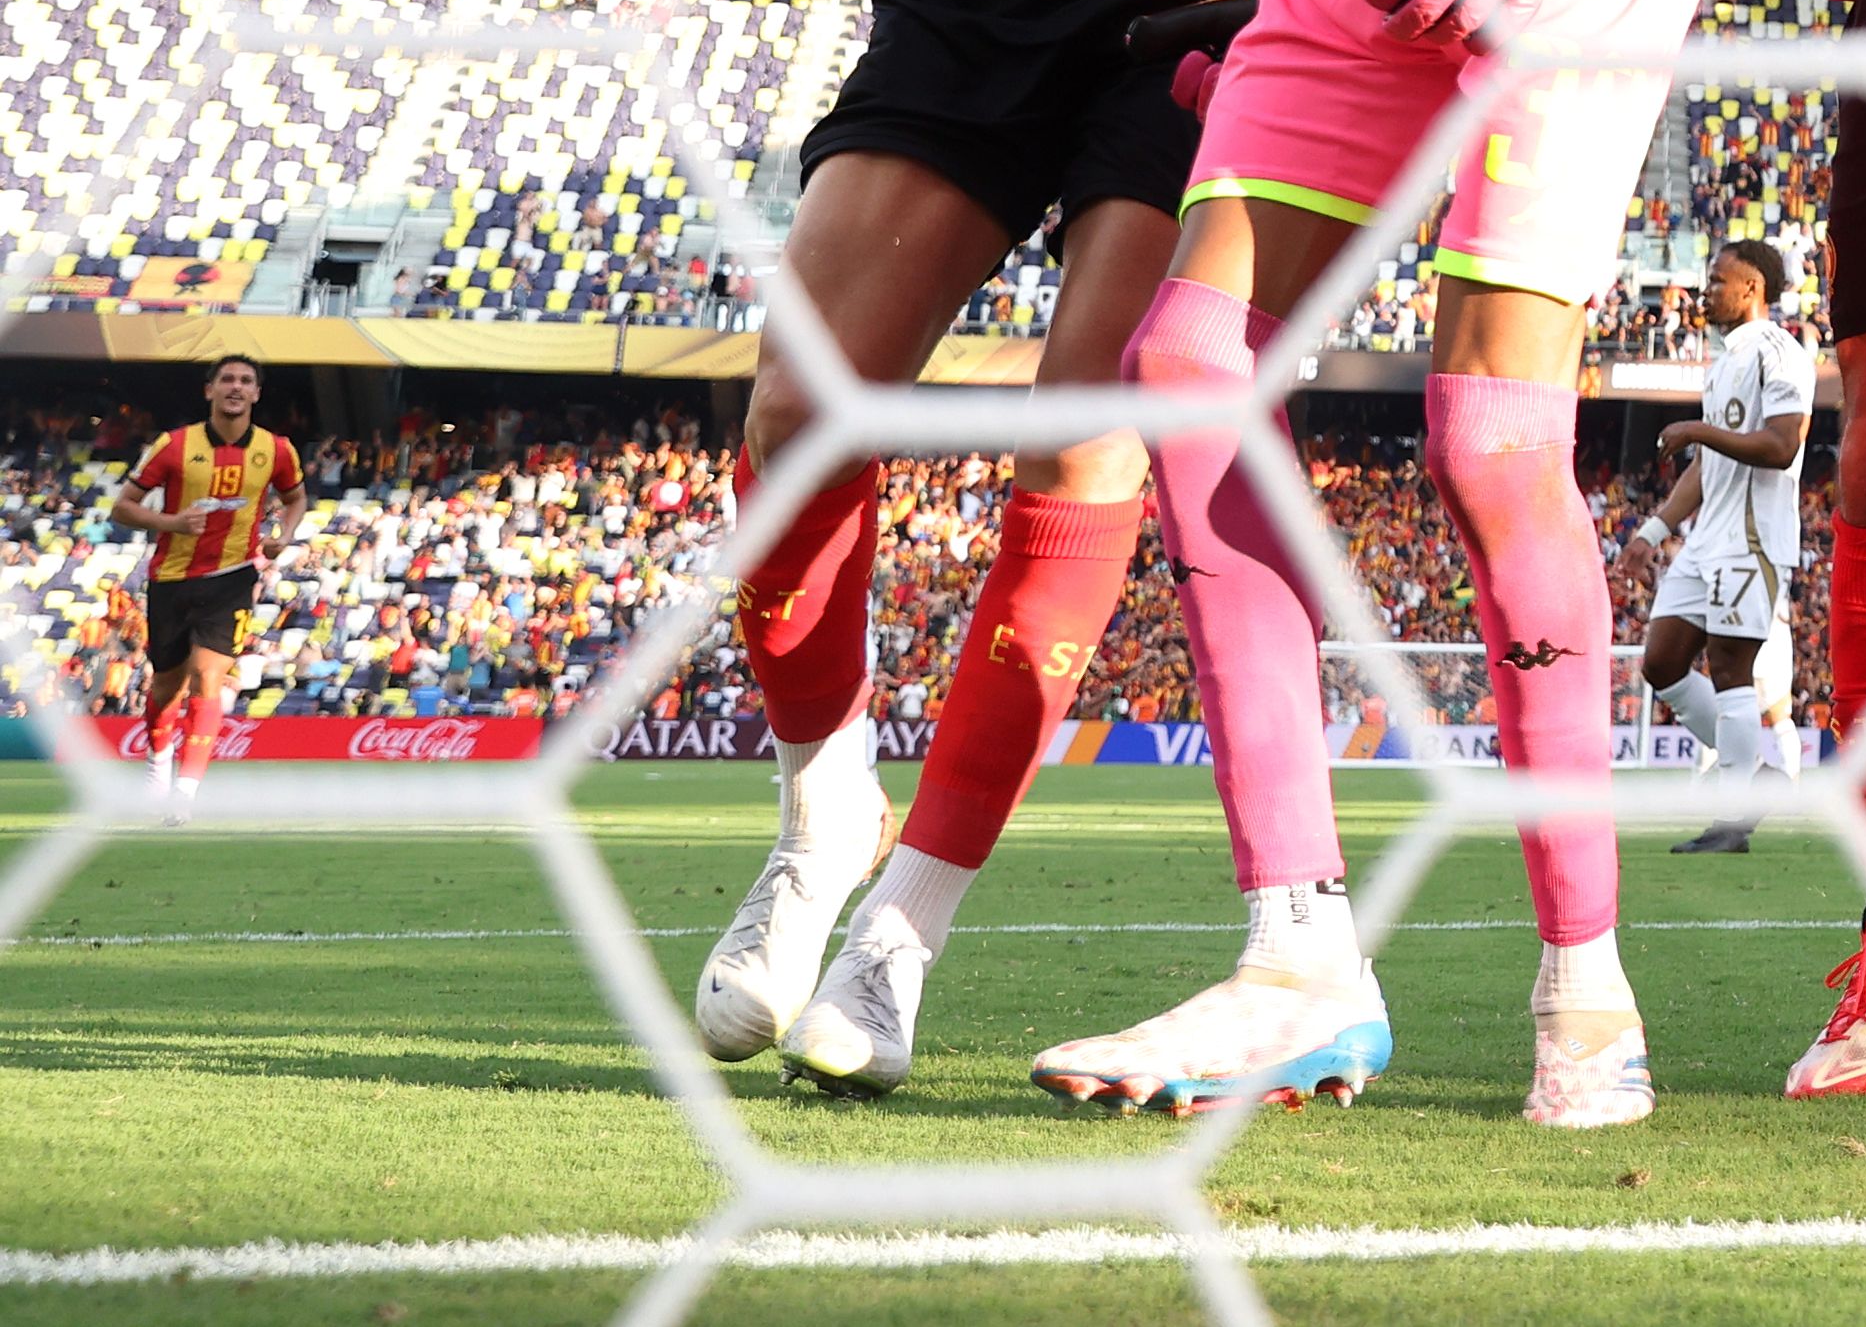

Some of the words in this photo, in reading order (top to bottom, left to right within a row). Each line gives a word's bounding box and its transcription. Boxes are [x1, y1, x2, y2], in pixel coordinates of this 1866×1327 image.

[213, 465, 241, 497] 19
[1709, 568, 1758, 608] 17
[349, 718, 487, 760] Coca-Cola
[586, 719, 738, 761] QATAR
[1145, 723, 1213, 764] VI
